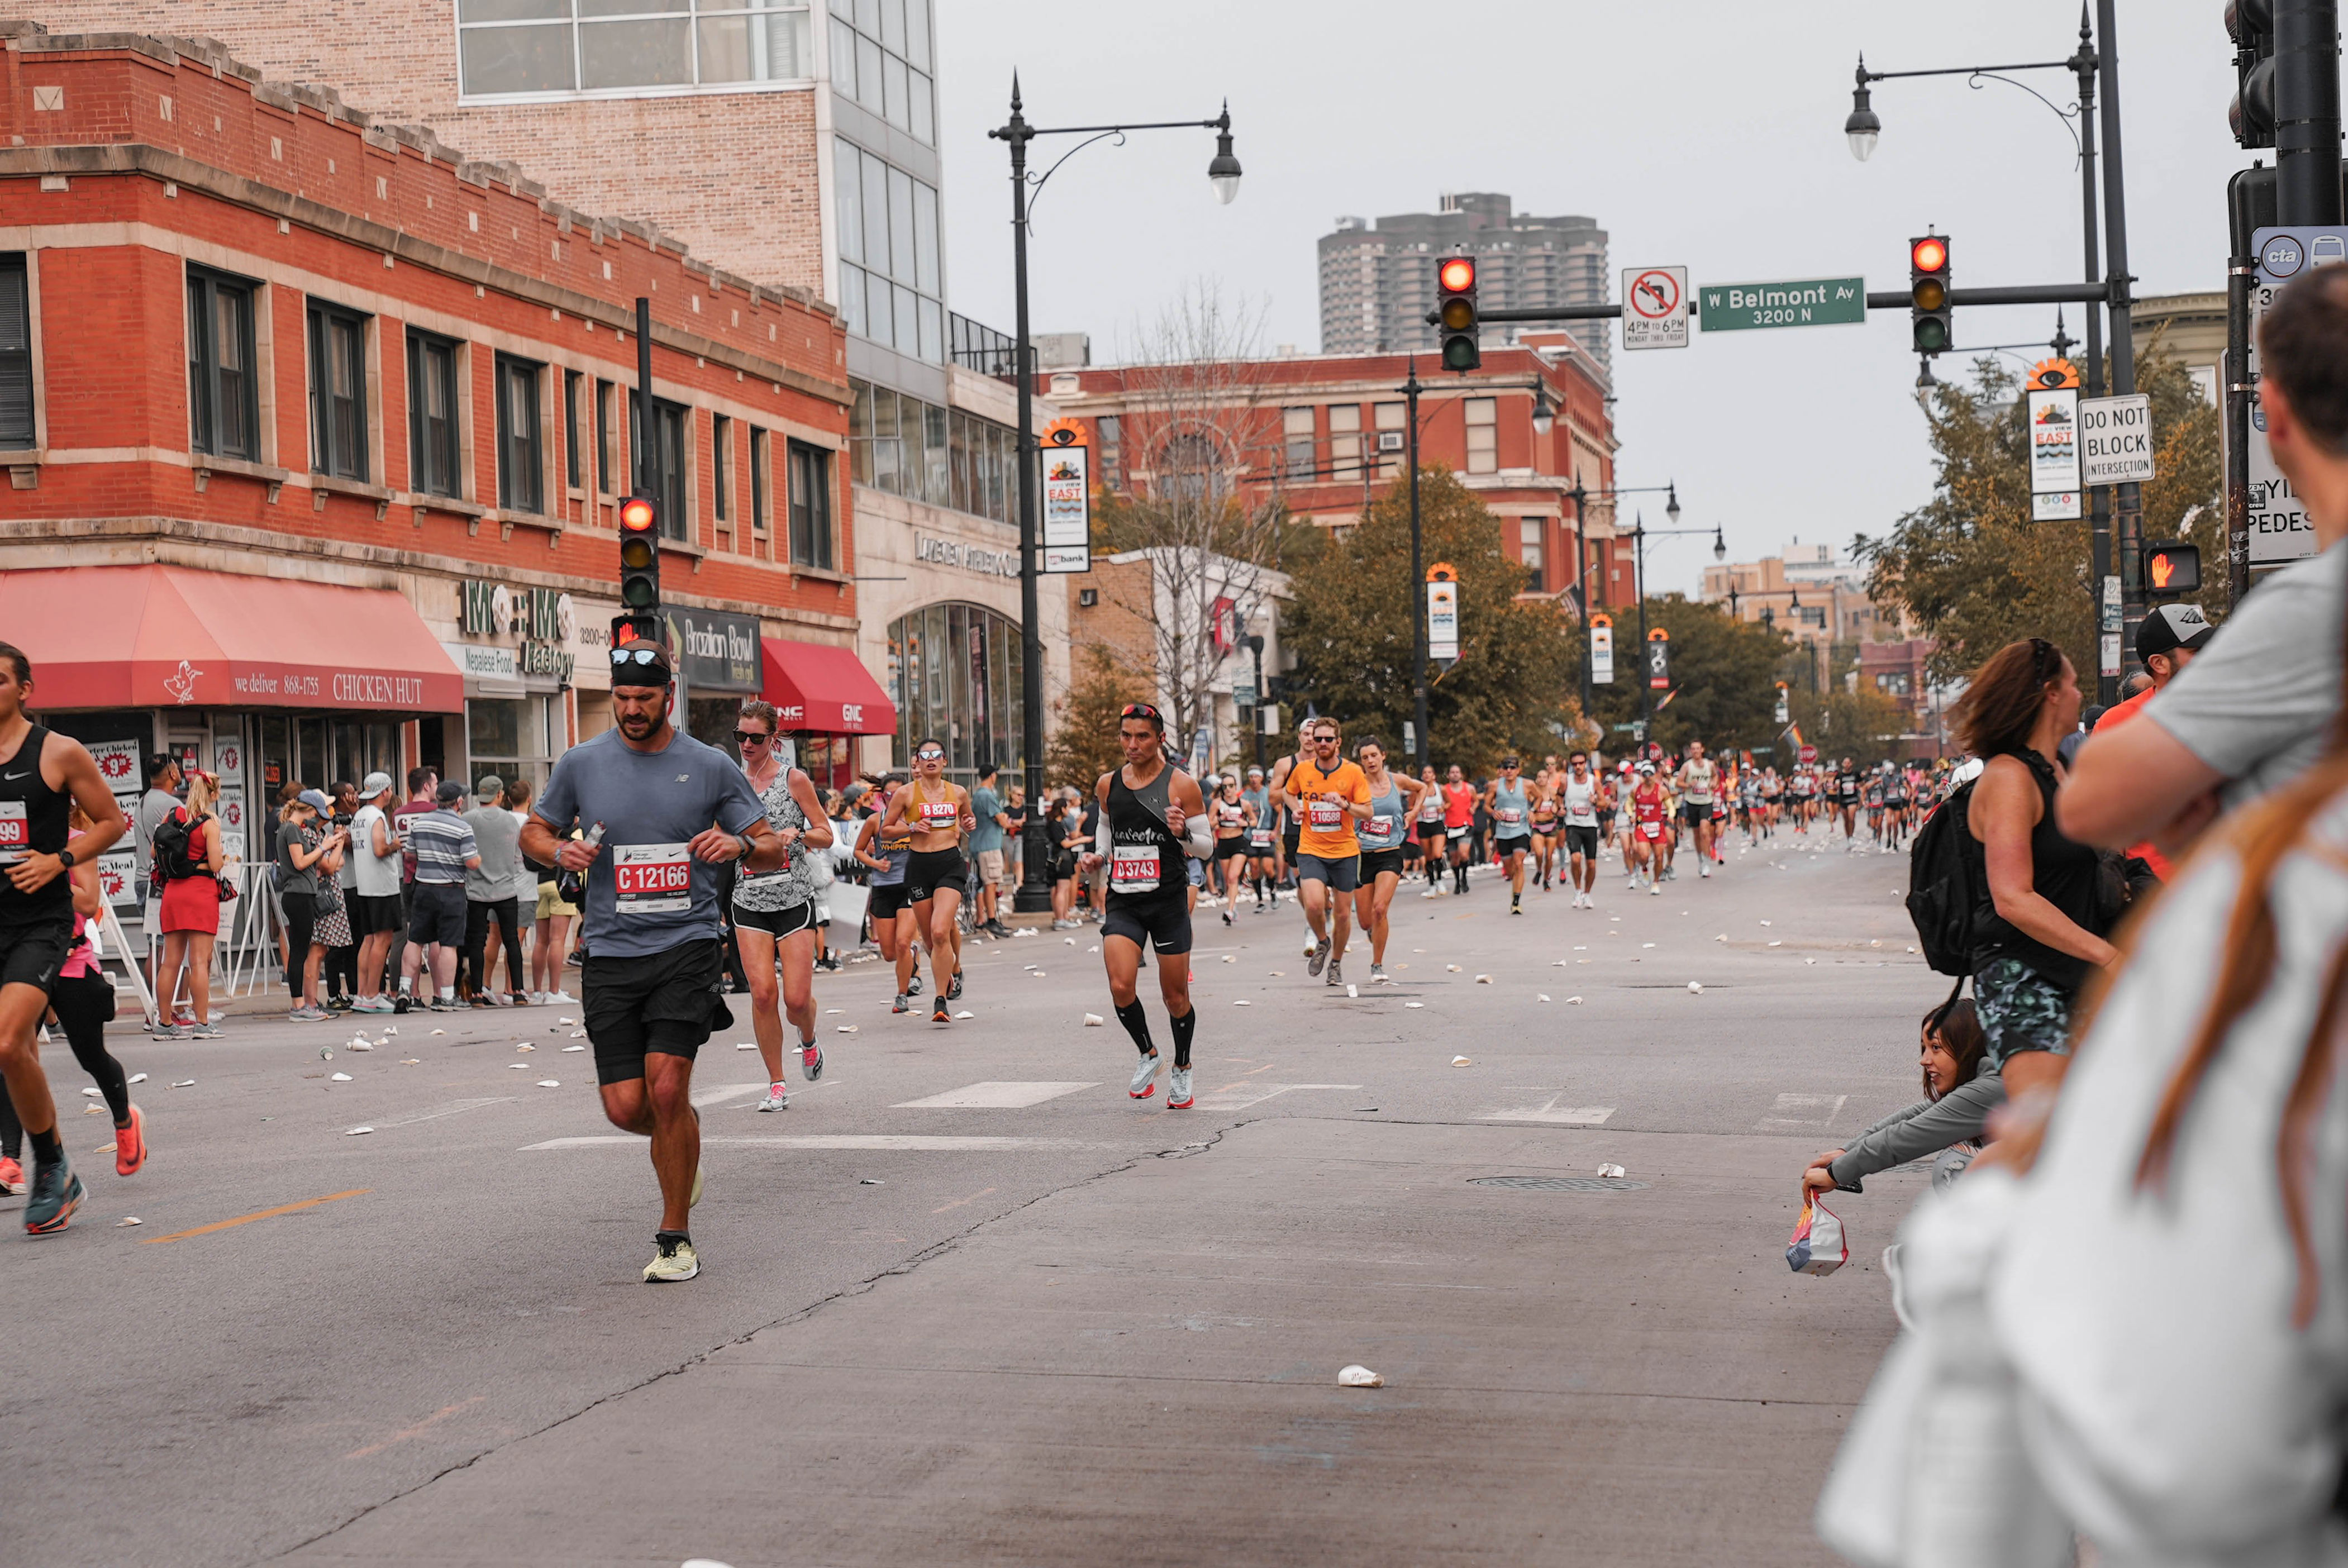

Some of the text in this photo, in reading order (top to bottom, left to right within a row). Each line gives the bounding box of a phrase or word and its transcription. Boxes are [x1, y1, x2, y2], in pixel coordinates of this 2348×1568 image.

[2268, 249, 2297, 263] cta
[1709, 284, 1855, 309] W Belmont Av
[1754, 308, 1812, 325] 3200 N
[1627, 320, 1649, 333] 4PM
[1662, 318, 1684, 332] 6PM
[1627, 335, 1647, 343] MONDAY
[2084, 407, 2145, 429] DO NOT
[2036, 432, 2073, 444] EAST
[2088, 434, 2146, 456] BLOCK
[2088, 459, 2149, 476] INTERSECTION
[1049, 488, 1081, 498] EAST
[2249, 512, 2315, 533] PEDES
[580, 628, 611, 646] 3200-0
[728, 625, 753, 662] Bowl
[465, 647, 512, 673] Nepalese Food
[524, 640, 574, 683] Factory
[235, 673, 422, 704] we deliver 868-1755 CHICKEN HUT
[774, 706, 803, 717] NC
[842, 703, 863, 722] GNC
[106, 744, 137, 752] Chicken
[1639, 749, 1662, 760] SOP
[1798, 750, 1816, 758] STOP
[265, 766, 279, 781] CLOSED
[923, 803, 954, 816] B 8270
[1311, 813, 1316, 822] C
[618, 865, 688, 889] C 12166
[1126, 861, 1155, 877] 3743
